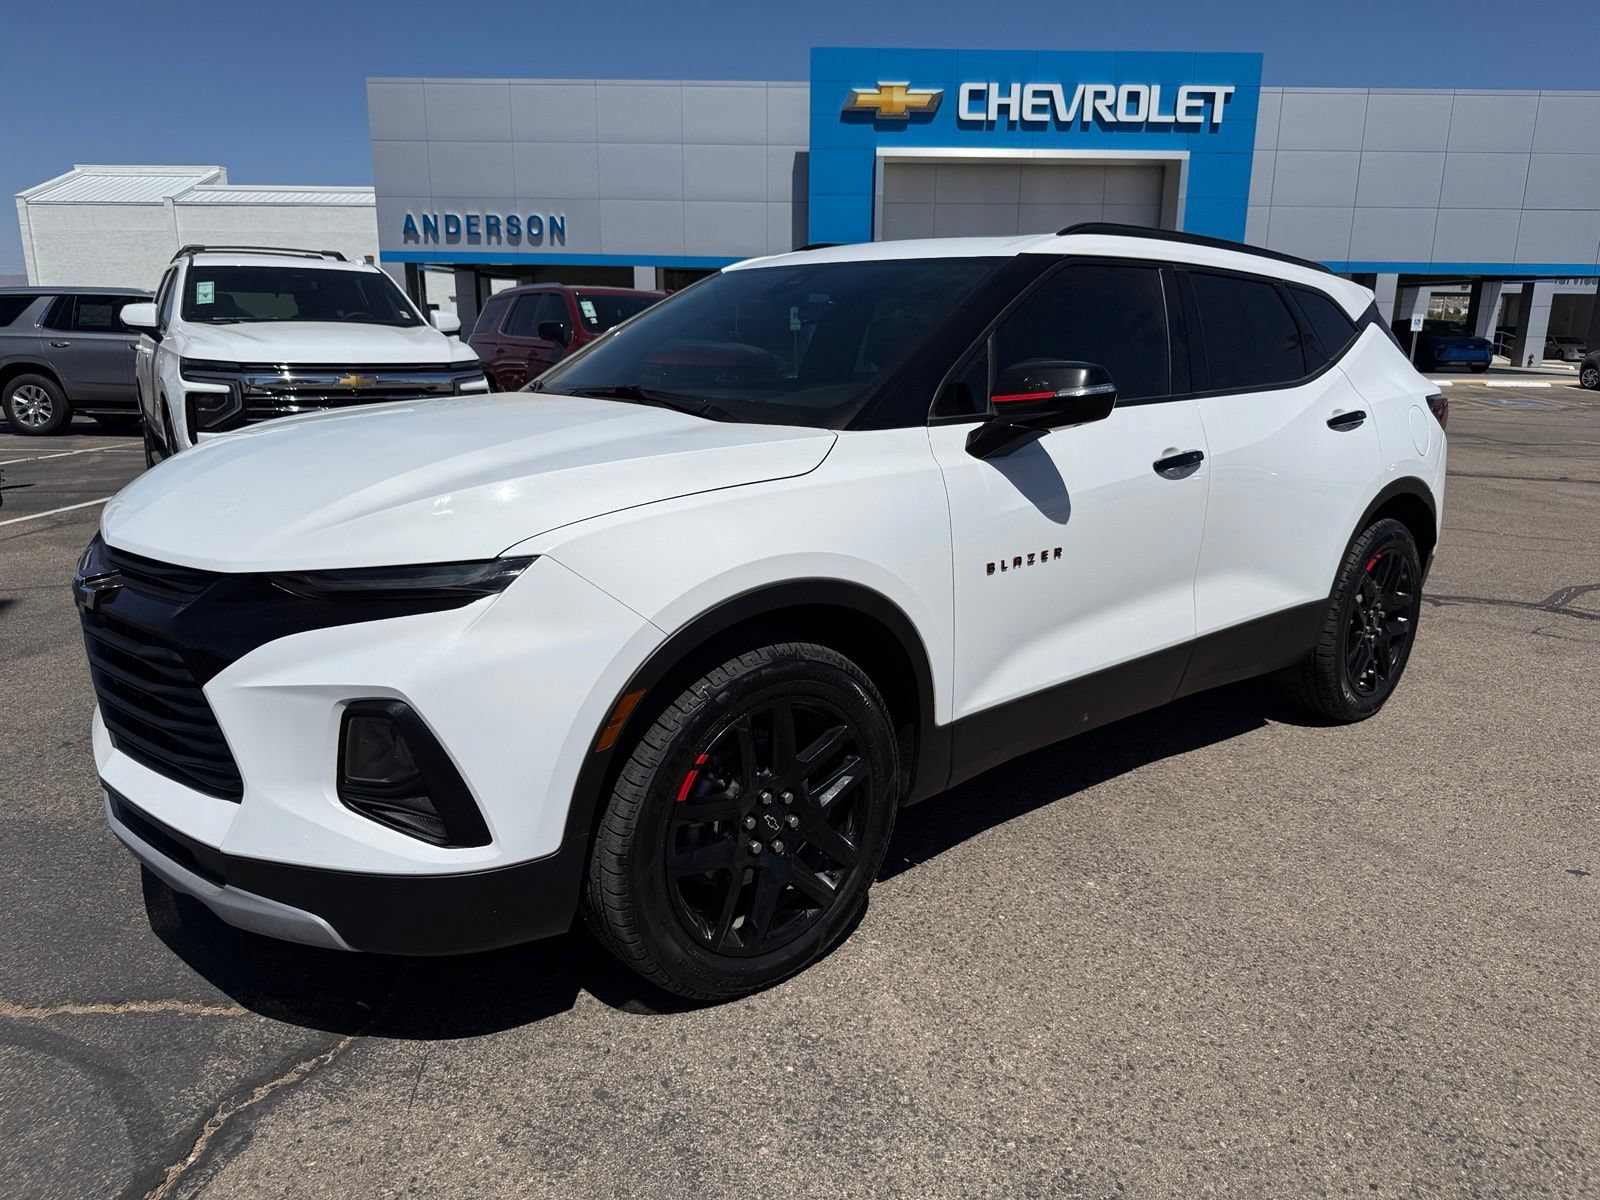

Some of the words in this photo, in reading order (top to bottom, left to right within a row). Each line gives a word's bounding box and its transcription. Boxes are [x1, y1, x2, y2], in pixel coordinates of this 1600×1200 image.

[958, 82, 1235, 123] CHEVROLET
[403, 213, 565, 237] ANDERSON
[986, 547, 1062, 576] BLAZER
